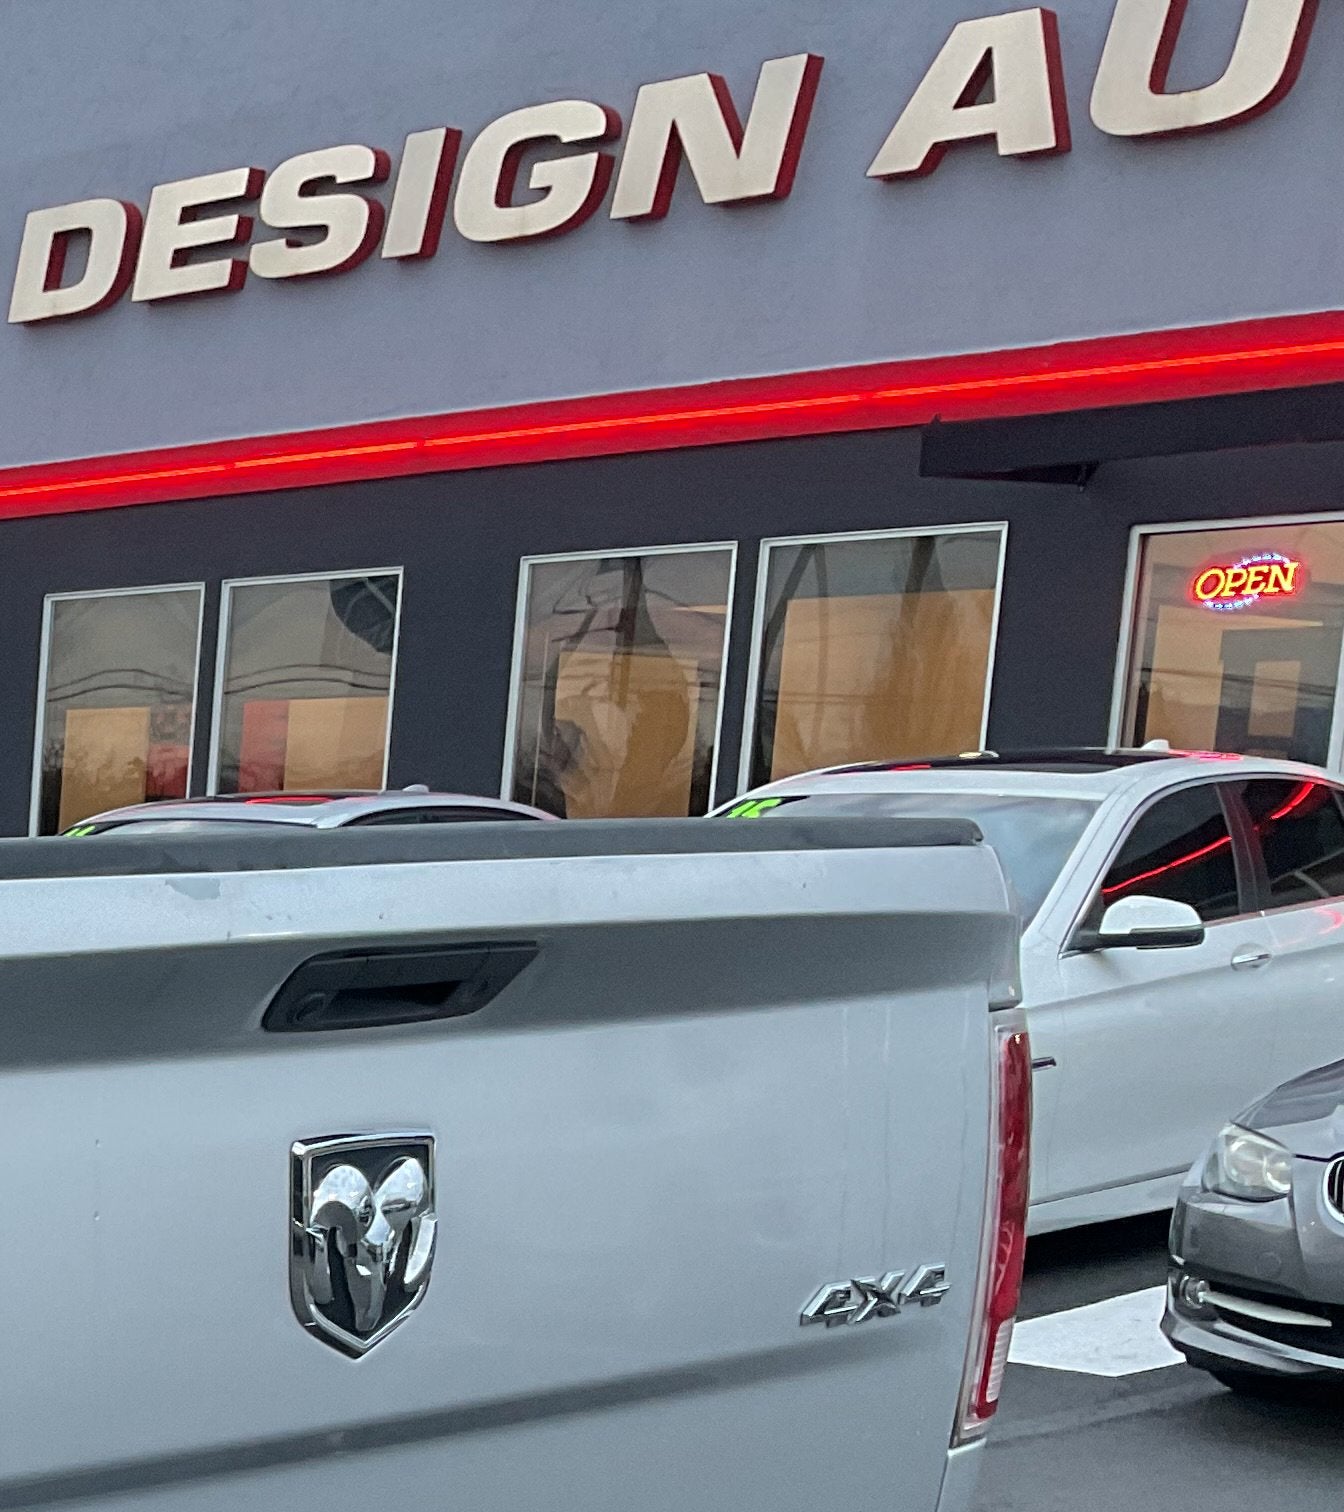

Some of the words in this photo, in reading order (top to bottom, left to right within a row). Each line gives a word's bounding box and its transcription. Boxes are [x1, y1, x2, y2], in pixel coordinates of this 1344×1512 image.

[8, 52, 823, 325] DESIGN
[864, 0, 1319, 178] AU
[1195, 560, 1298, 601] OPEN
